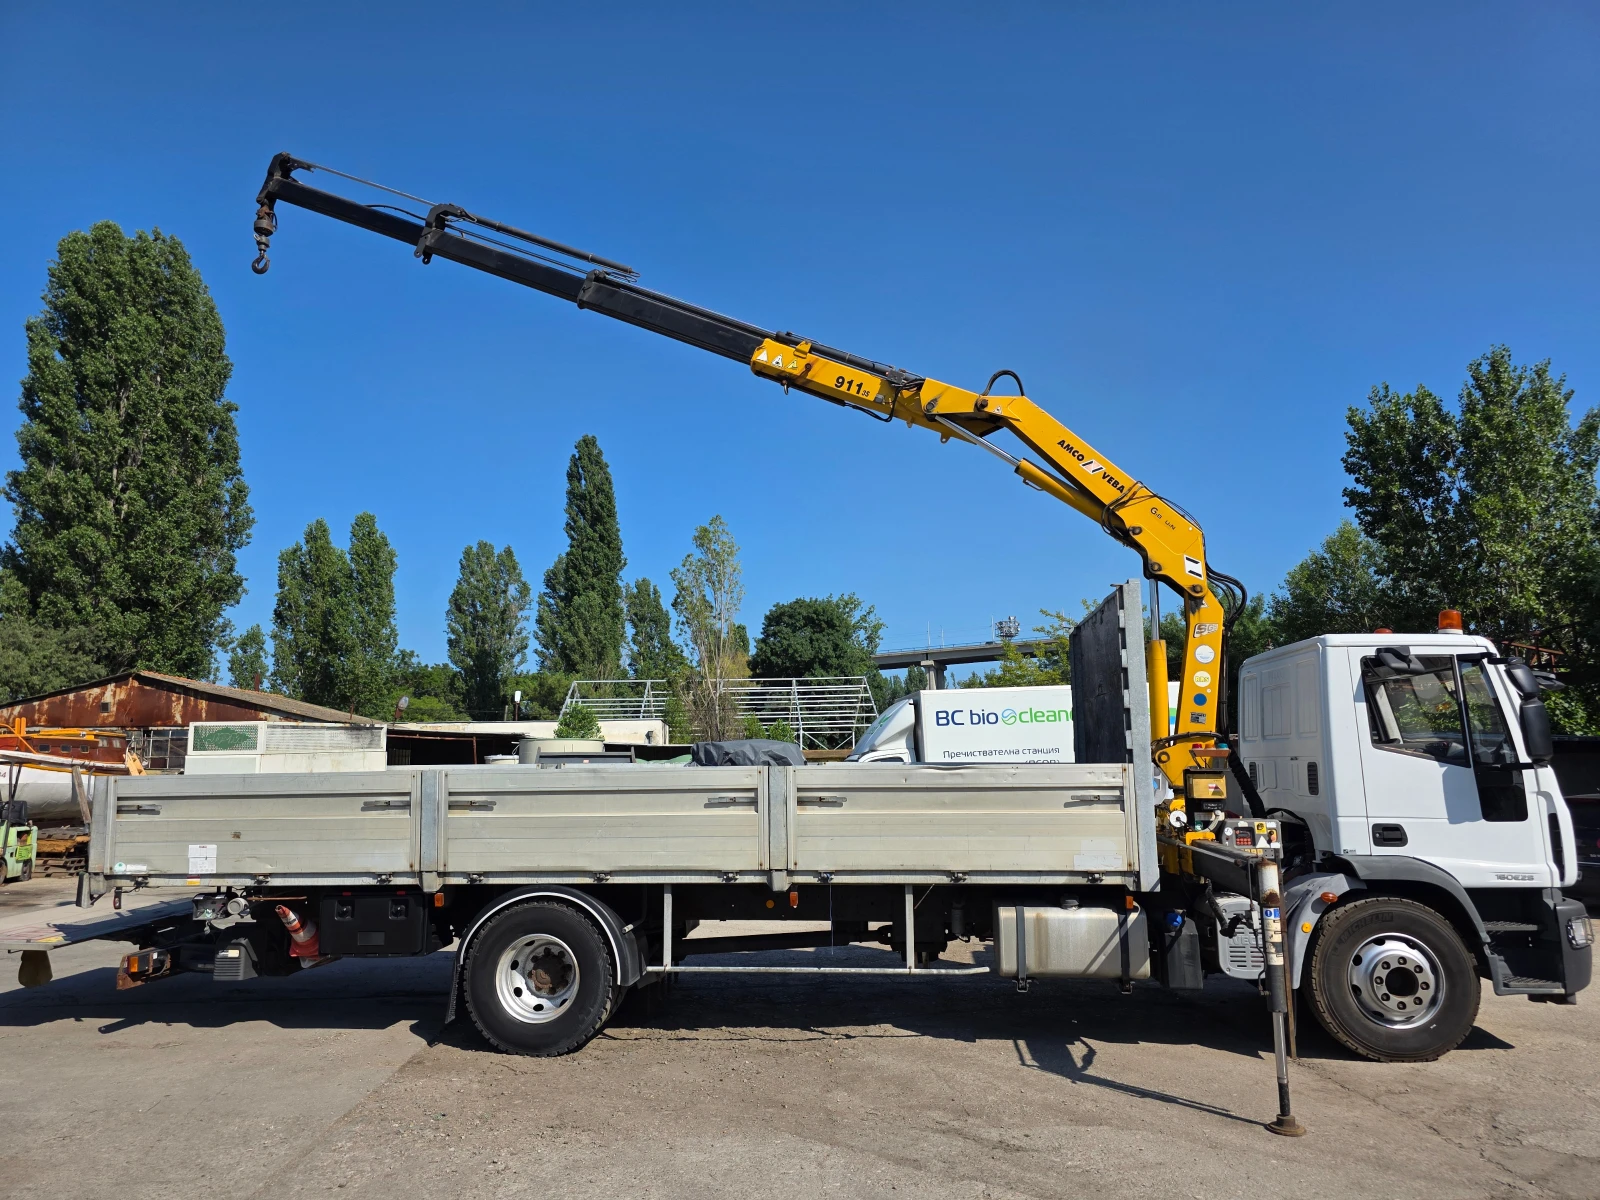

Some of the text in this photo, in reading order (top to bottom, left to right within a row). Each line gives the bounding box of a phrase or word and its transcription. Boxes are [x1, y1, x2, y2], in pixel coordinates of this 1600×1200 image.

[834, 375, 863, 395] 911
[1056, 439, 1126, 494] AMCO VEBA
[935, 709, 965, 727] BC
[970, 708, 999, 726] bio
[942, 747, 1060, 759] Пречиствателна станция
